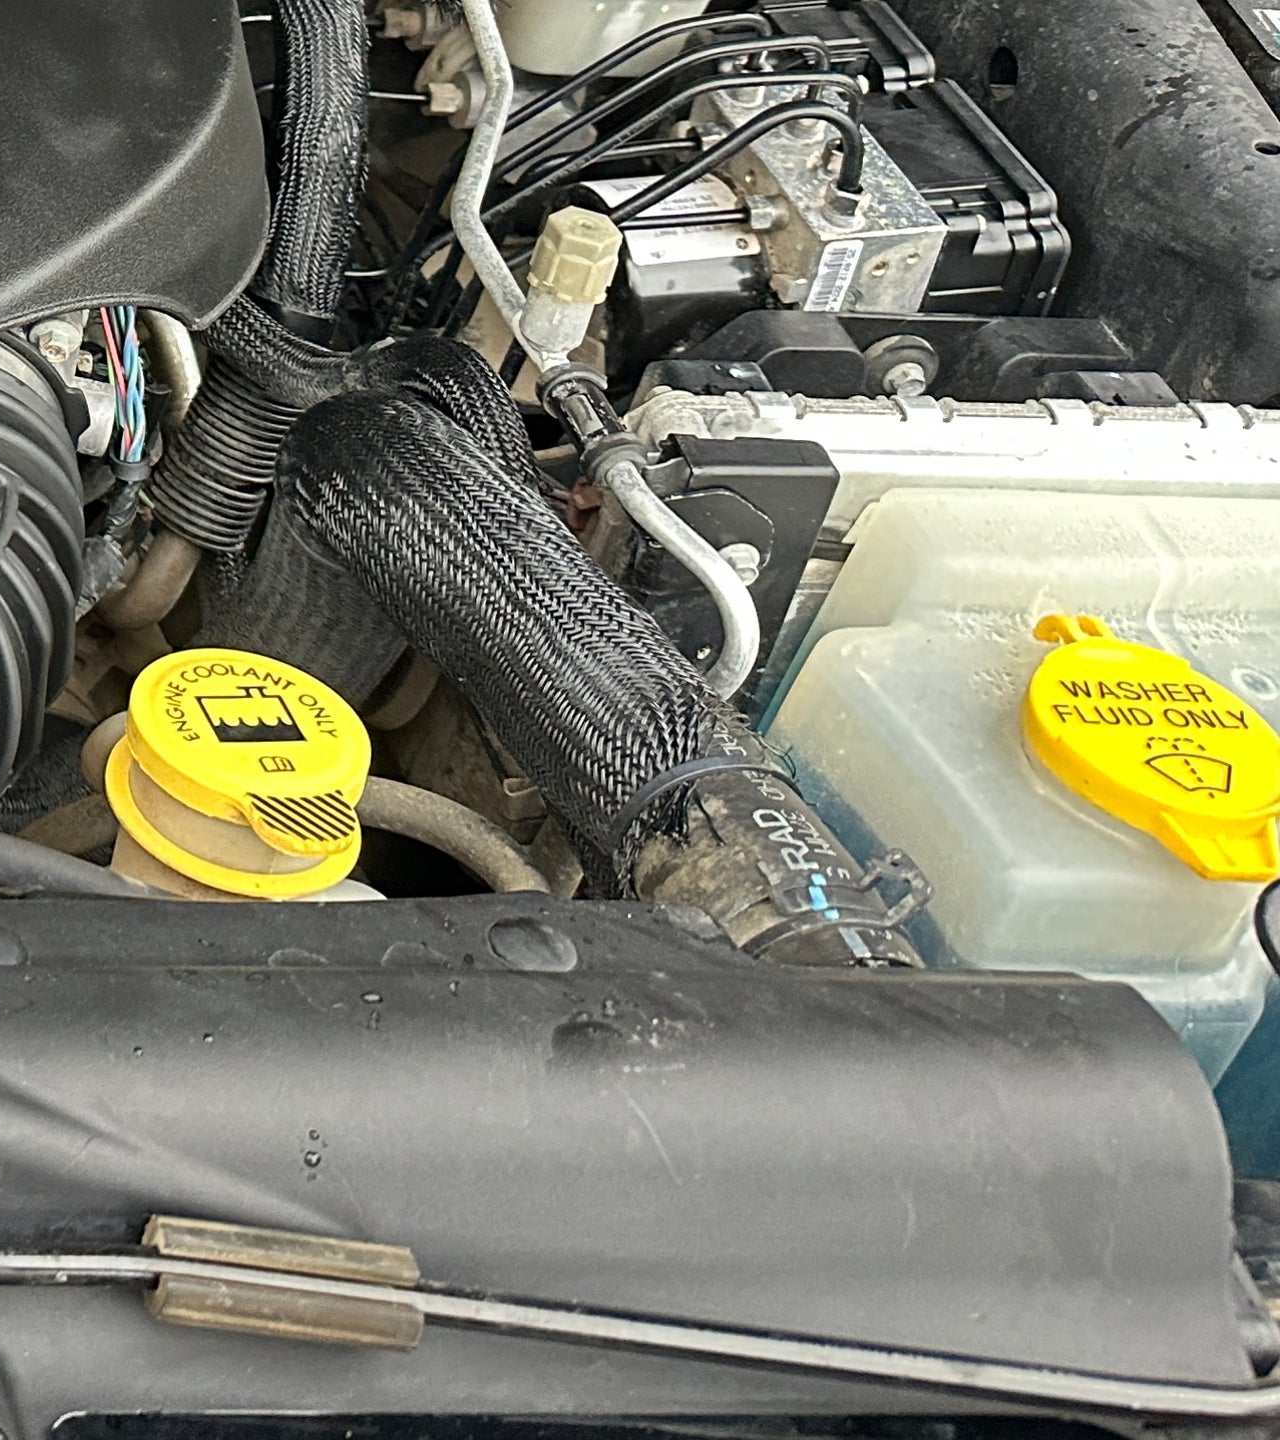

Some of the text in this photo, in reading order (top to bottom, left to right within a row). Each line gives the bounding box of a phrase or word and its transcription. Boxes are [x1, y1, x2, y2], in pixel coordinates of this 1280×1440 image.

[164, 663, 339, 742] ENGINE COOLANT ONLY
[1058, 679, 1213, 703] WASHER
[1052, 704, 1249, 730] FLUID ONLY
[753, 808, 820, 870] RAD
